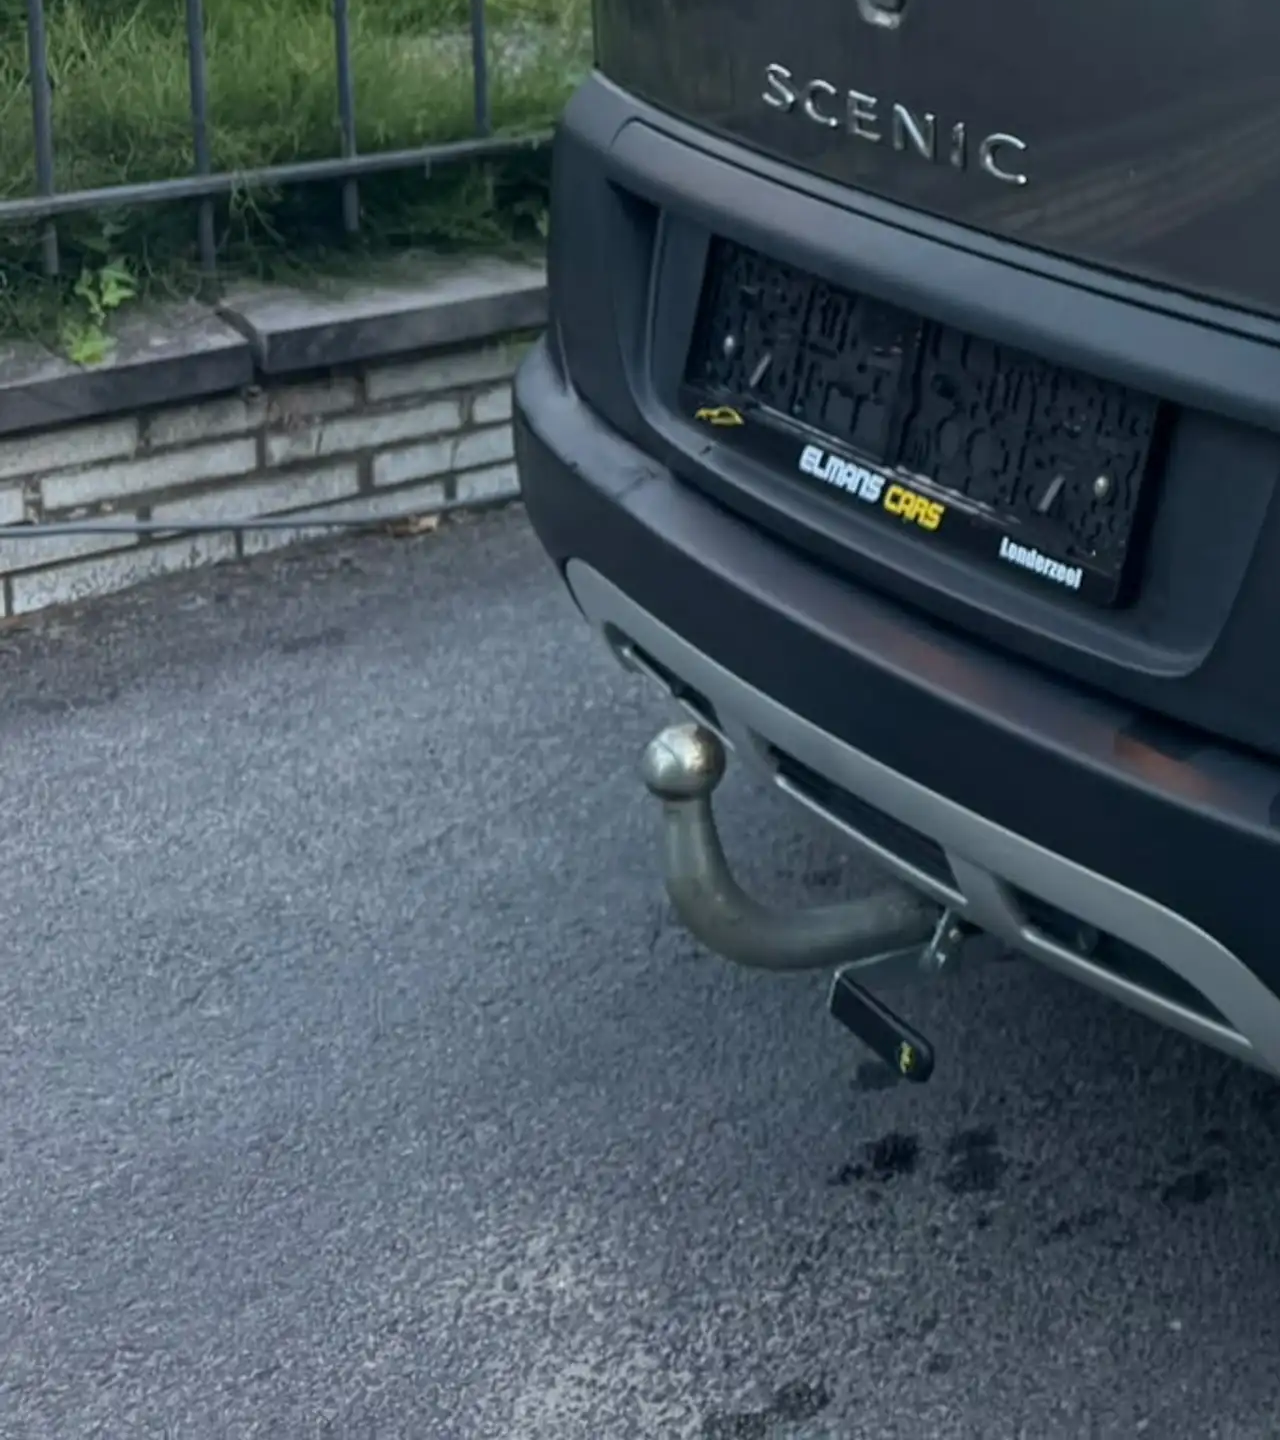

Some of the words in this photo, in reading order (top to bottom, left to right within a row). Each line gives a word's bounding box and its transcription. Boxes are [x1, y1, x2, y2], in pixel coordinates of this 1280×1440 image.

[761, 62, 1028, 185] SCENIC
[799, 444, 886, 504] ELMANS
[883, 483, 945, 531] CARS
[999, 536, 1083, 590] Londerzeel
